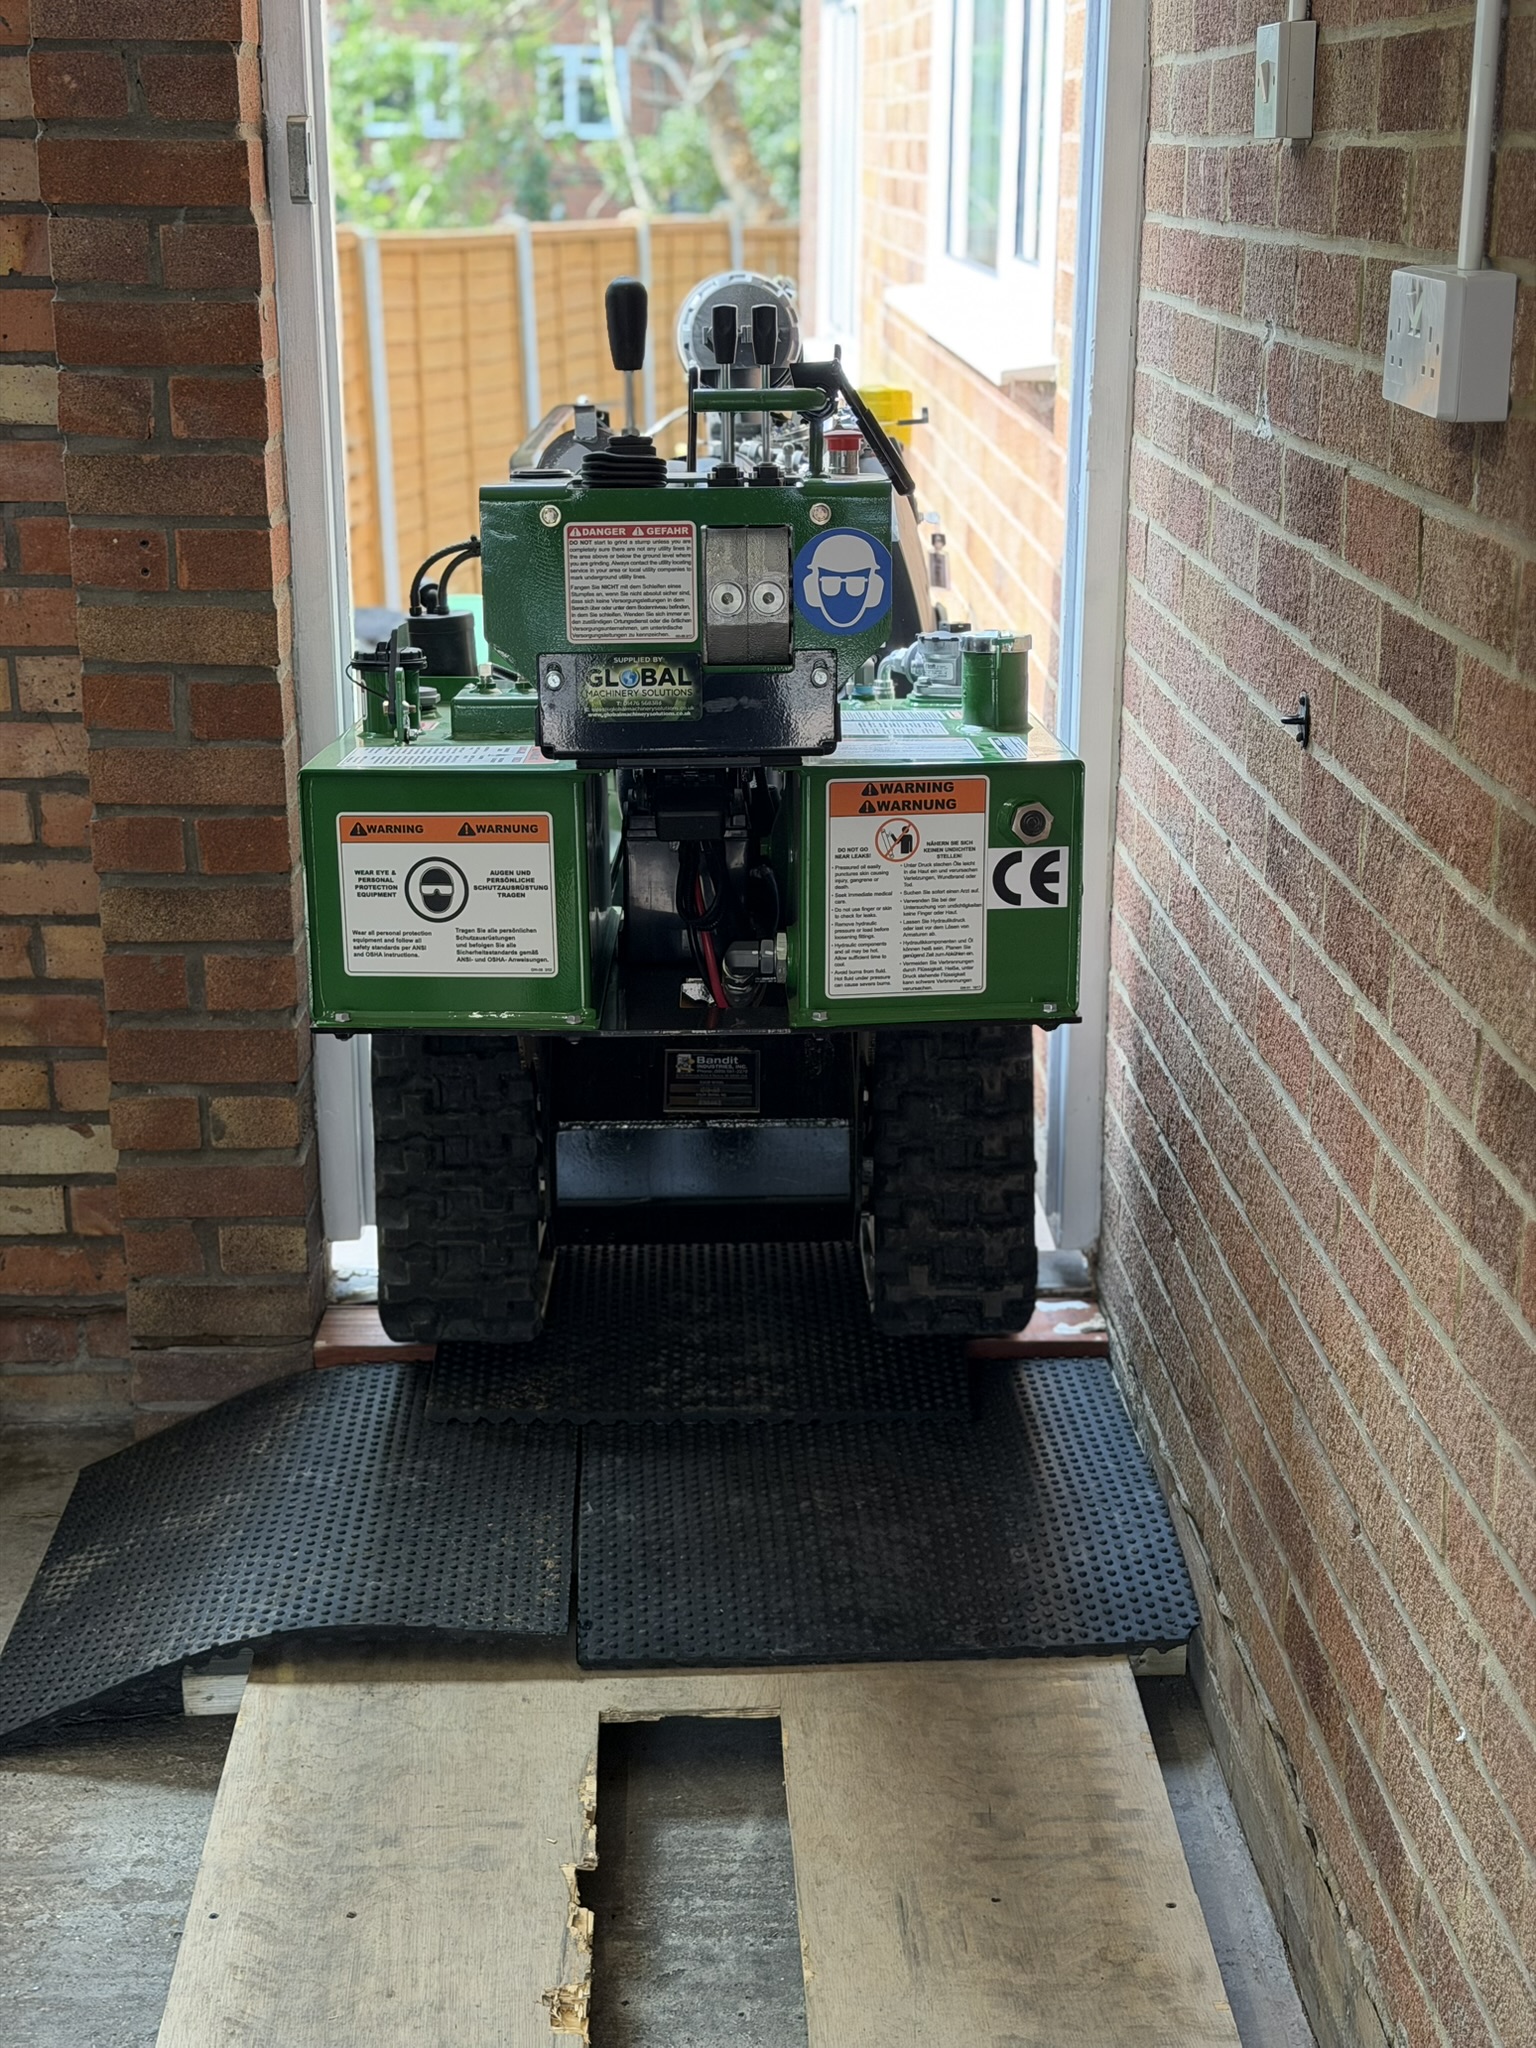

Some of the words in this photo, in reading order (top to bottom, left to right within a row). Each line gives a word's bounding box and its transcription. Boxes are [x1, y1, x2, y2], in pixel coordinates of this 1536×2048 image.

[582, 528, 626, 536] DANGER
[646, 526, 689, 535] GEFAHR
[586, 668, 692, 688] GLOBAL
[586, 689, 639, 698] MACHINERY
[642, 688, 693, 696] SOLUTIONS
[879, 782, 954, 794] WARNING
[876, 798, 956, 812] WARNUNG
[367, 825, 424, 834] WARNING
[475, 824, 538, 833] WARNUNG
[992, 850, 1060, 906] CE
